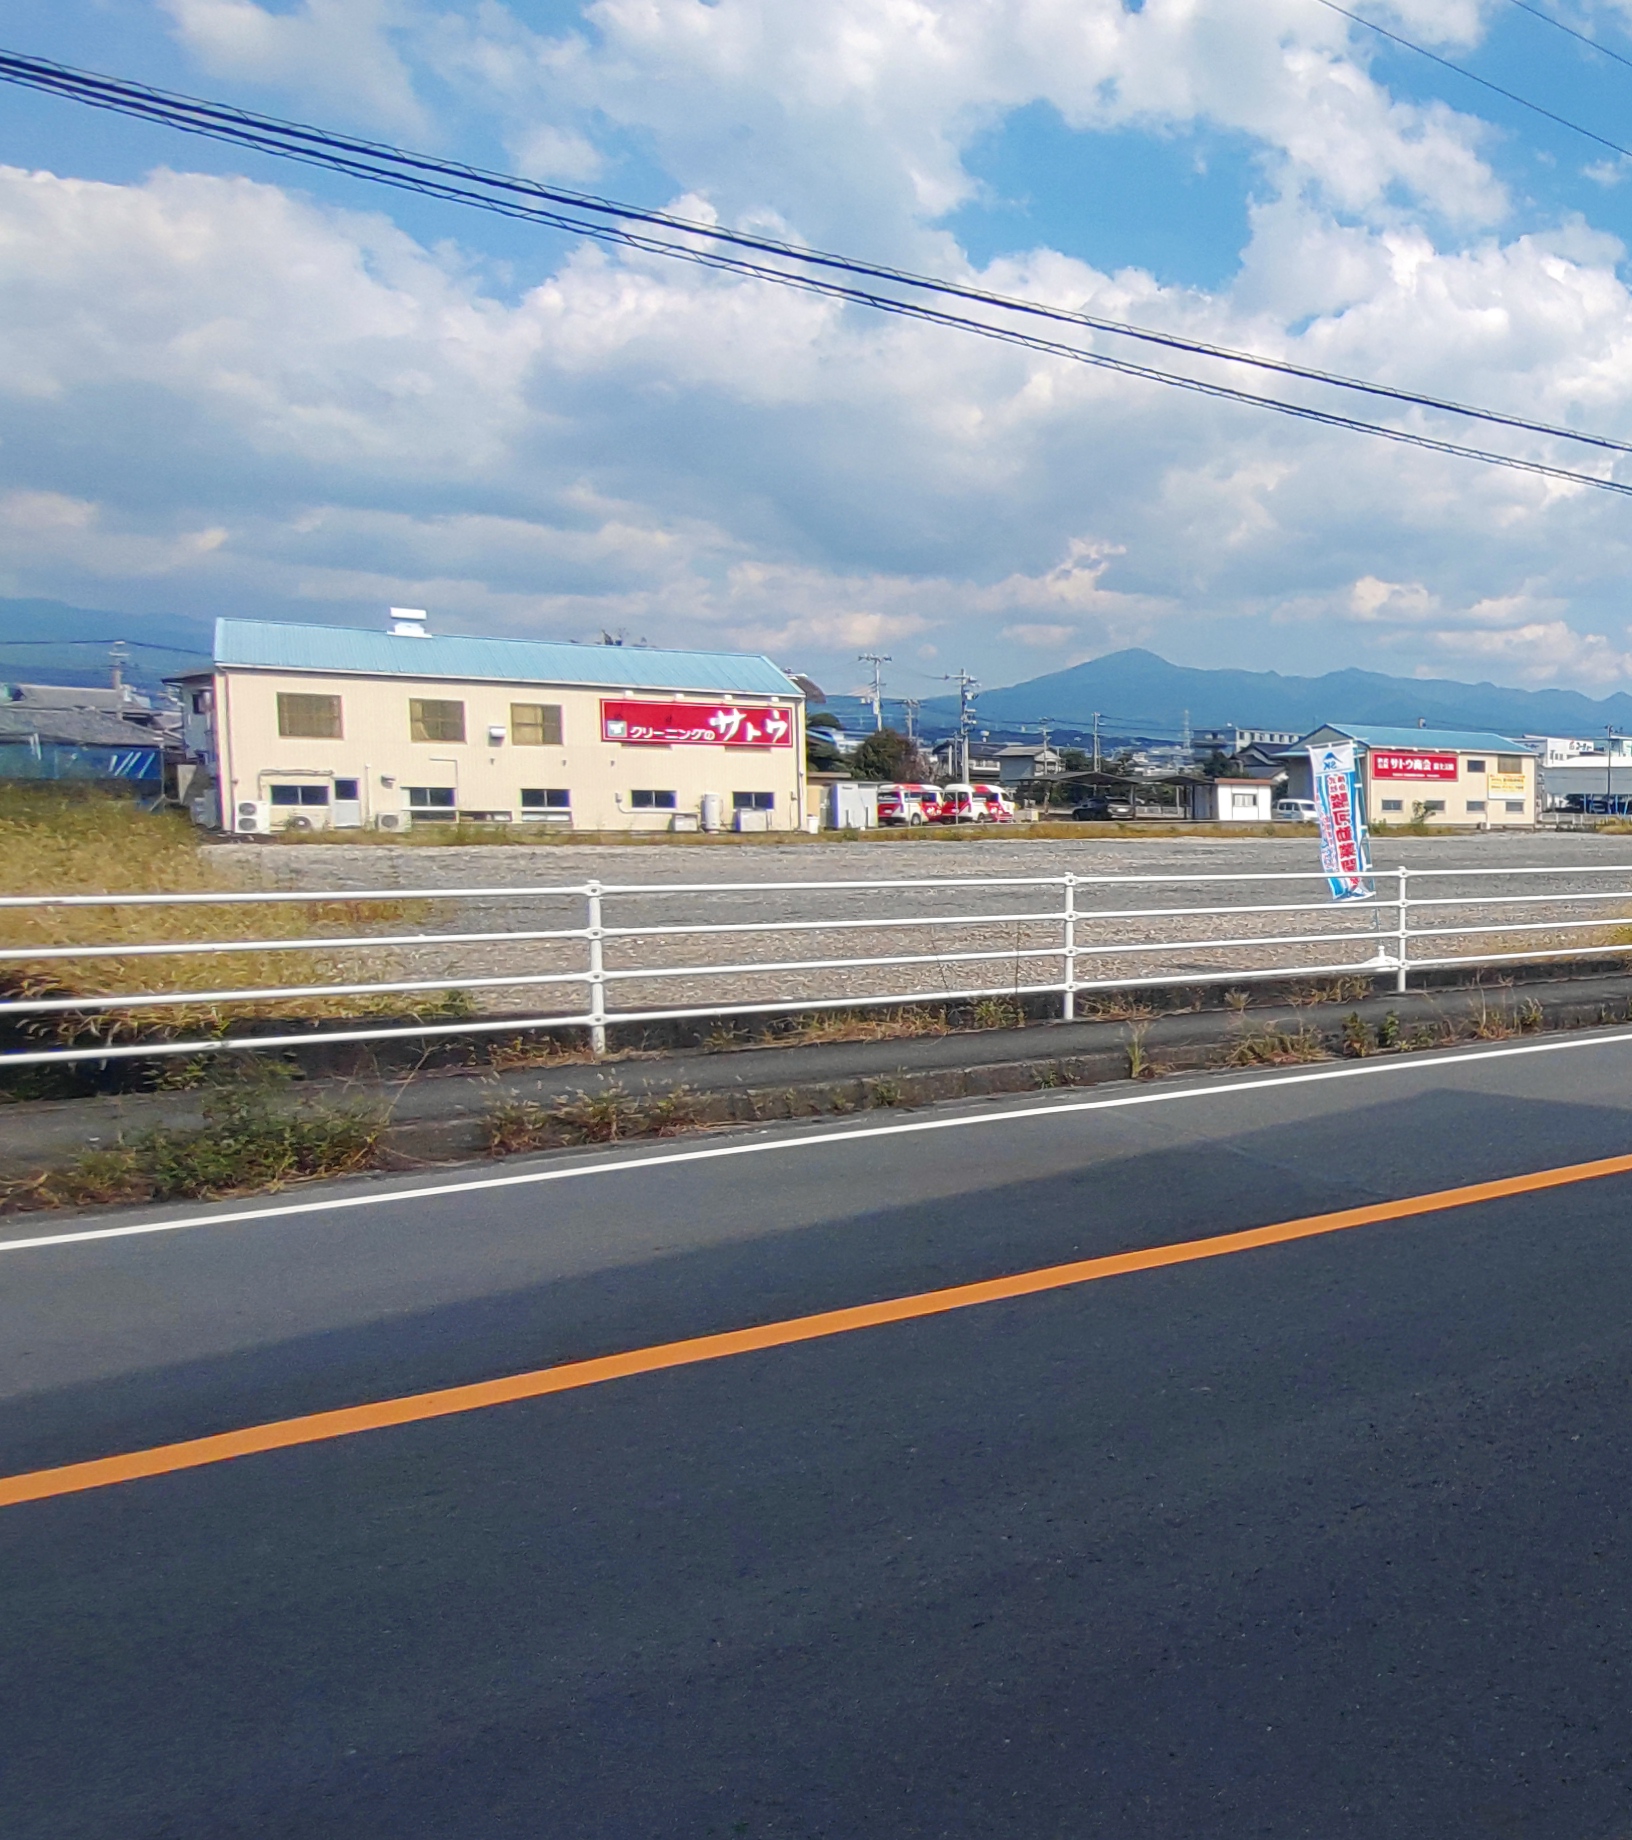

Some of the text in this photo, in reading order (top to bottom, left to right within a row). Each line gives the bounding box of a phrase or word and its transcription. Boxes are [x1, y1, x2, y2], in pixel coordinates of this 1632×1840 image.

[630, 708, 788, 743] クリーニングの サトウ
[1390, 758, 1431, 771] サトウ商会
